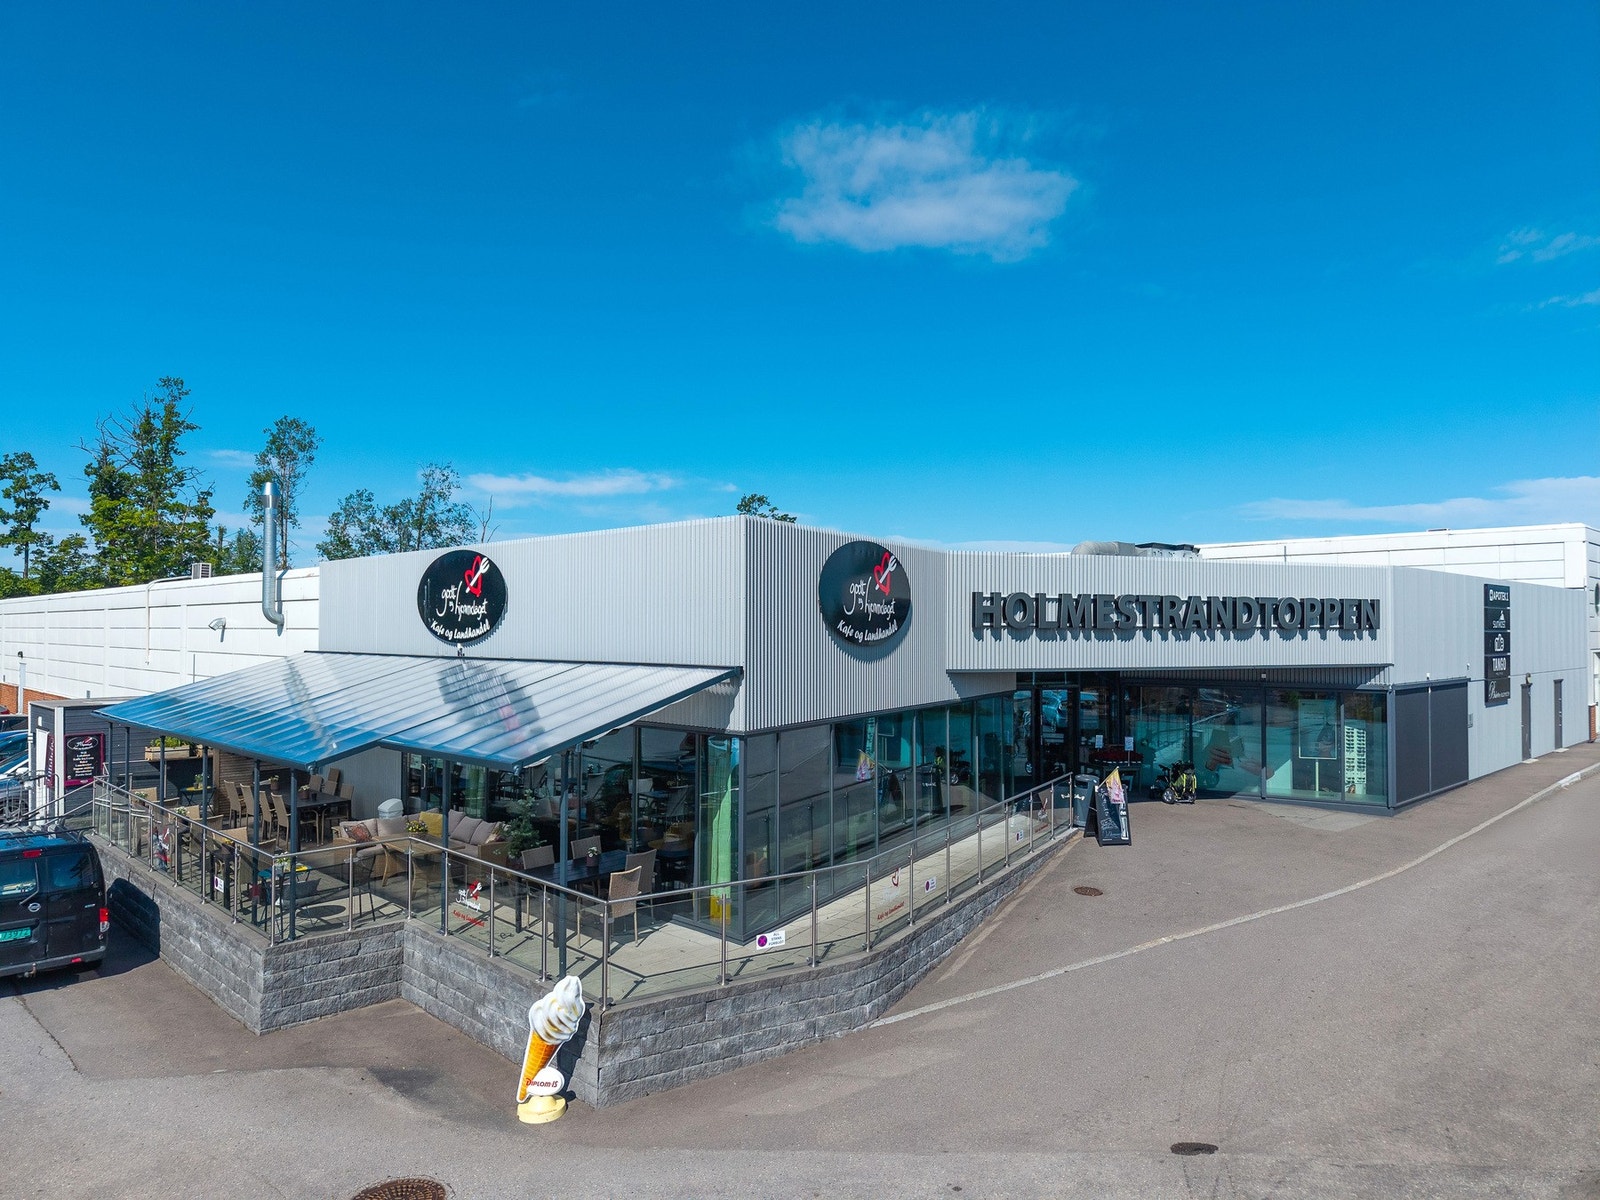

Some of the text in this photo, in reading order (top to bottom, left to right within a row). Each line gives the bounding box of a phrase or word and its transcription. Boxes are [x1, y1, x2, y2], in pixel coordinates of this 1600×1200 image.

[972, 591, 1380, 630] HOLMESTRANDTOPPEN
[445, 631, 453, 640] og
[854, 631, 864, 643] og
